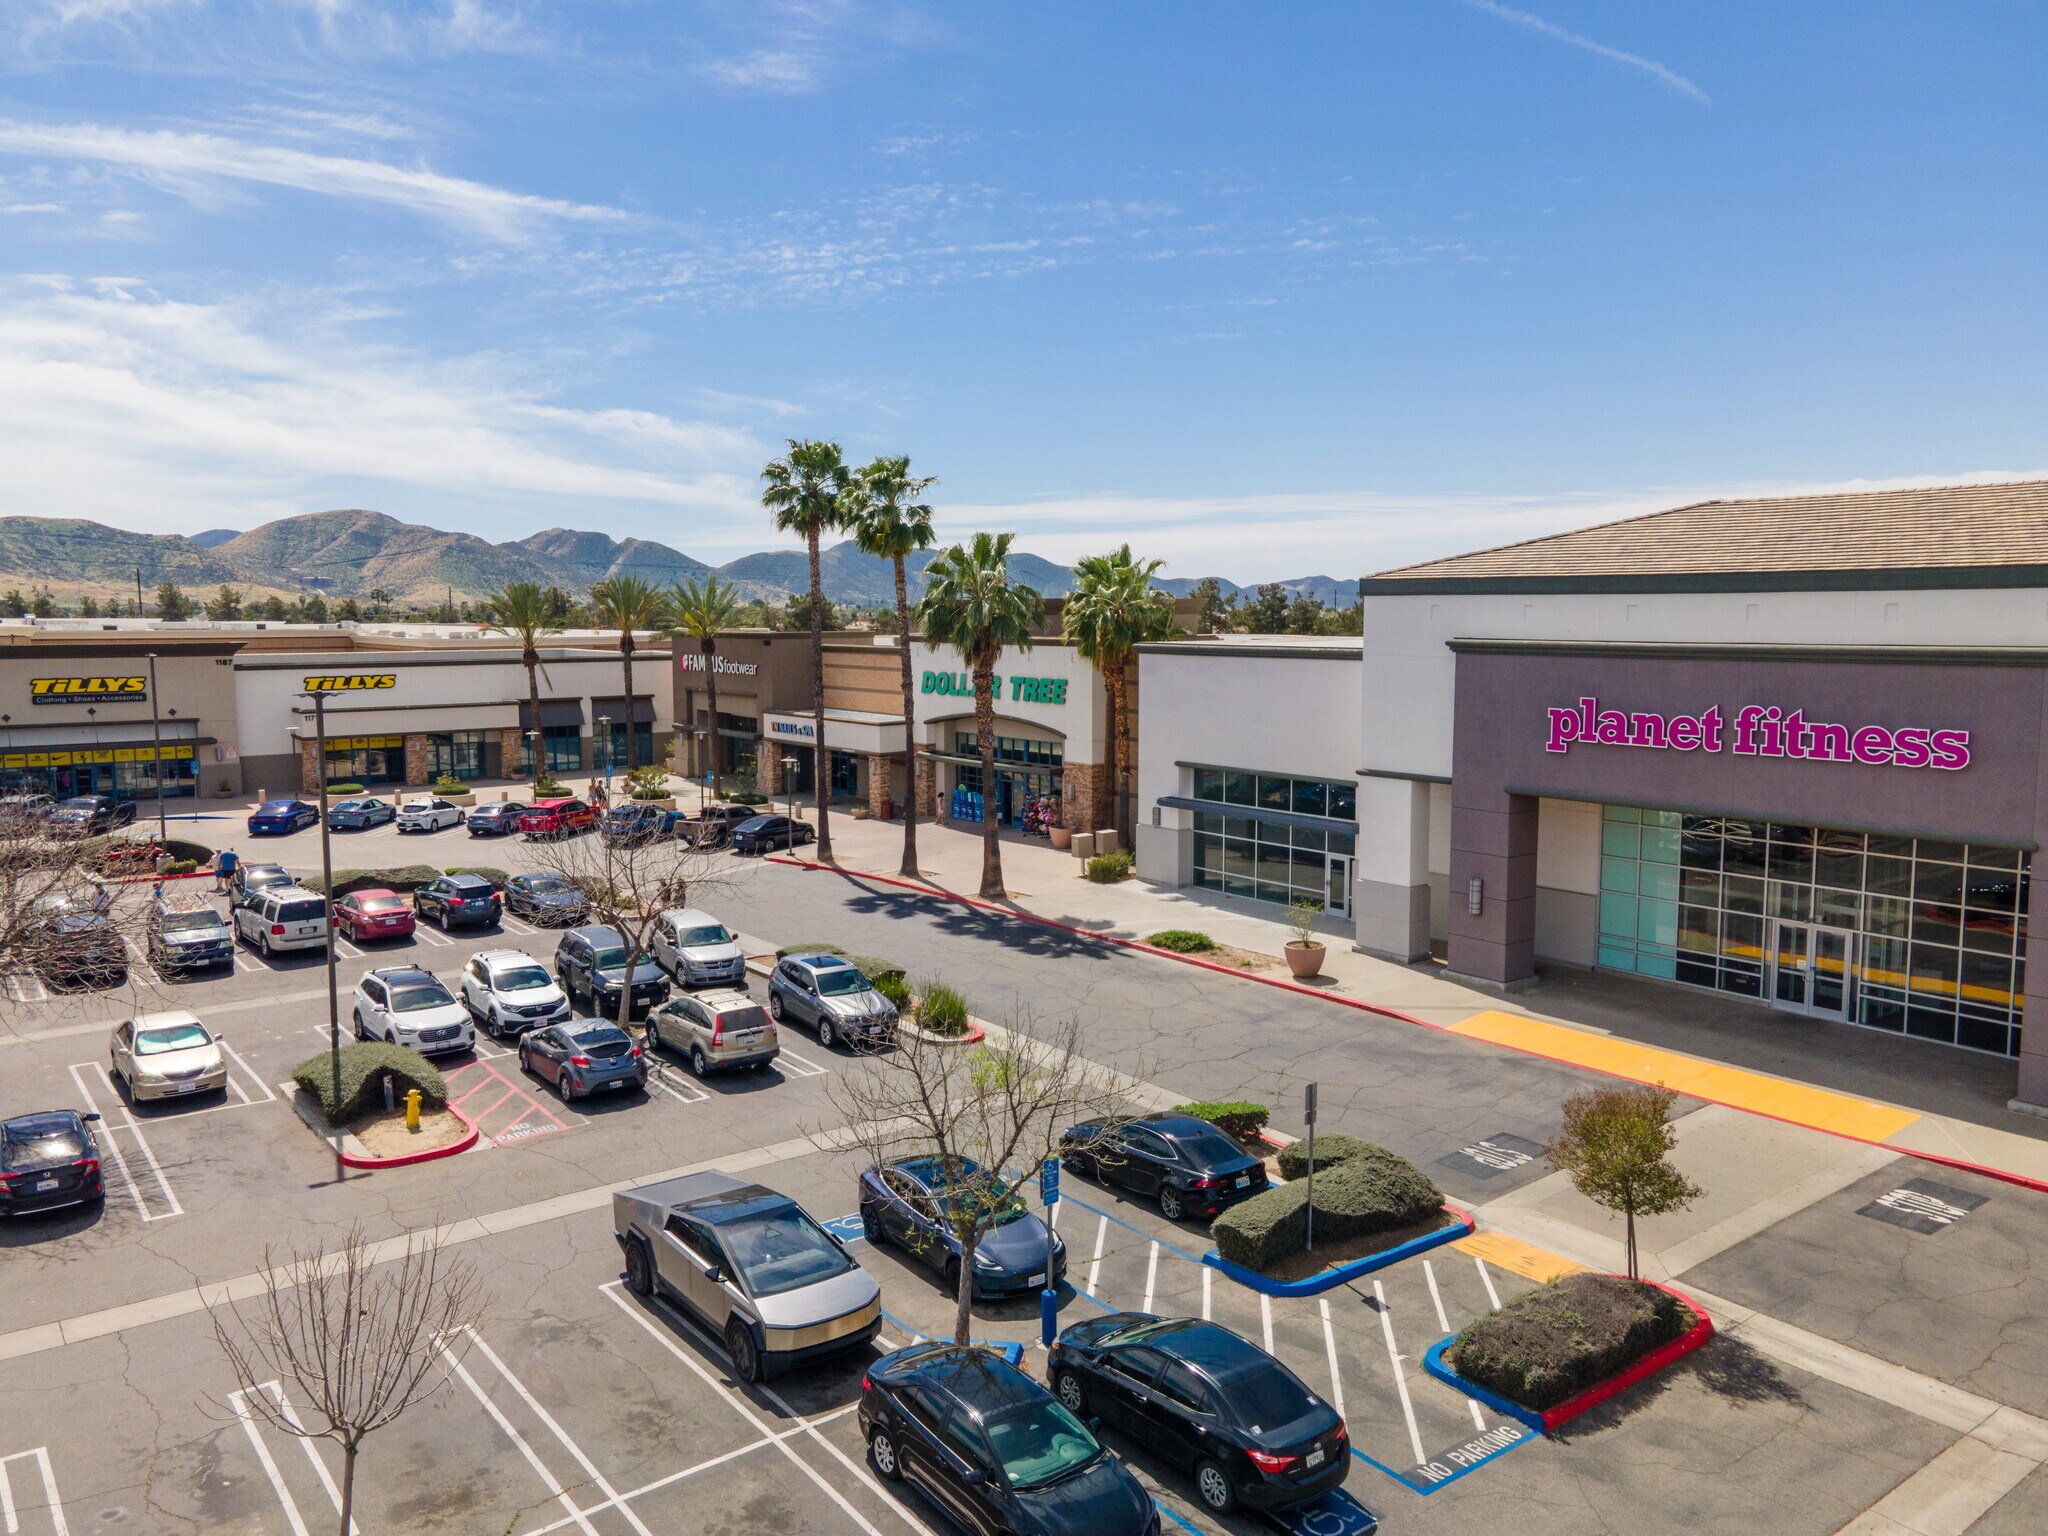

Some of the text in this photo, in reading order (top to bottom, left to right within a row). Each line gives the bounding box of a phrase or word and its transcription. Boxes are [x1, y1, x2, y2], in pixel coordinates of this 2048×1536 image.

[688, 654, 724, 673] FAMUS
[921, 671, 1068, 704] DOLLR TREE
[802, 725, 814, 737] SPA
[1546, 697, 1970, 770] planet fitness
[495, 1123, 557, 1142] PARKING
[510, 1122, 530, 1131] NO
[1416, 1426, 1522, 1483] NO PARKING
